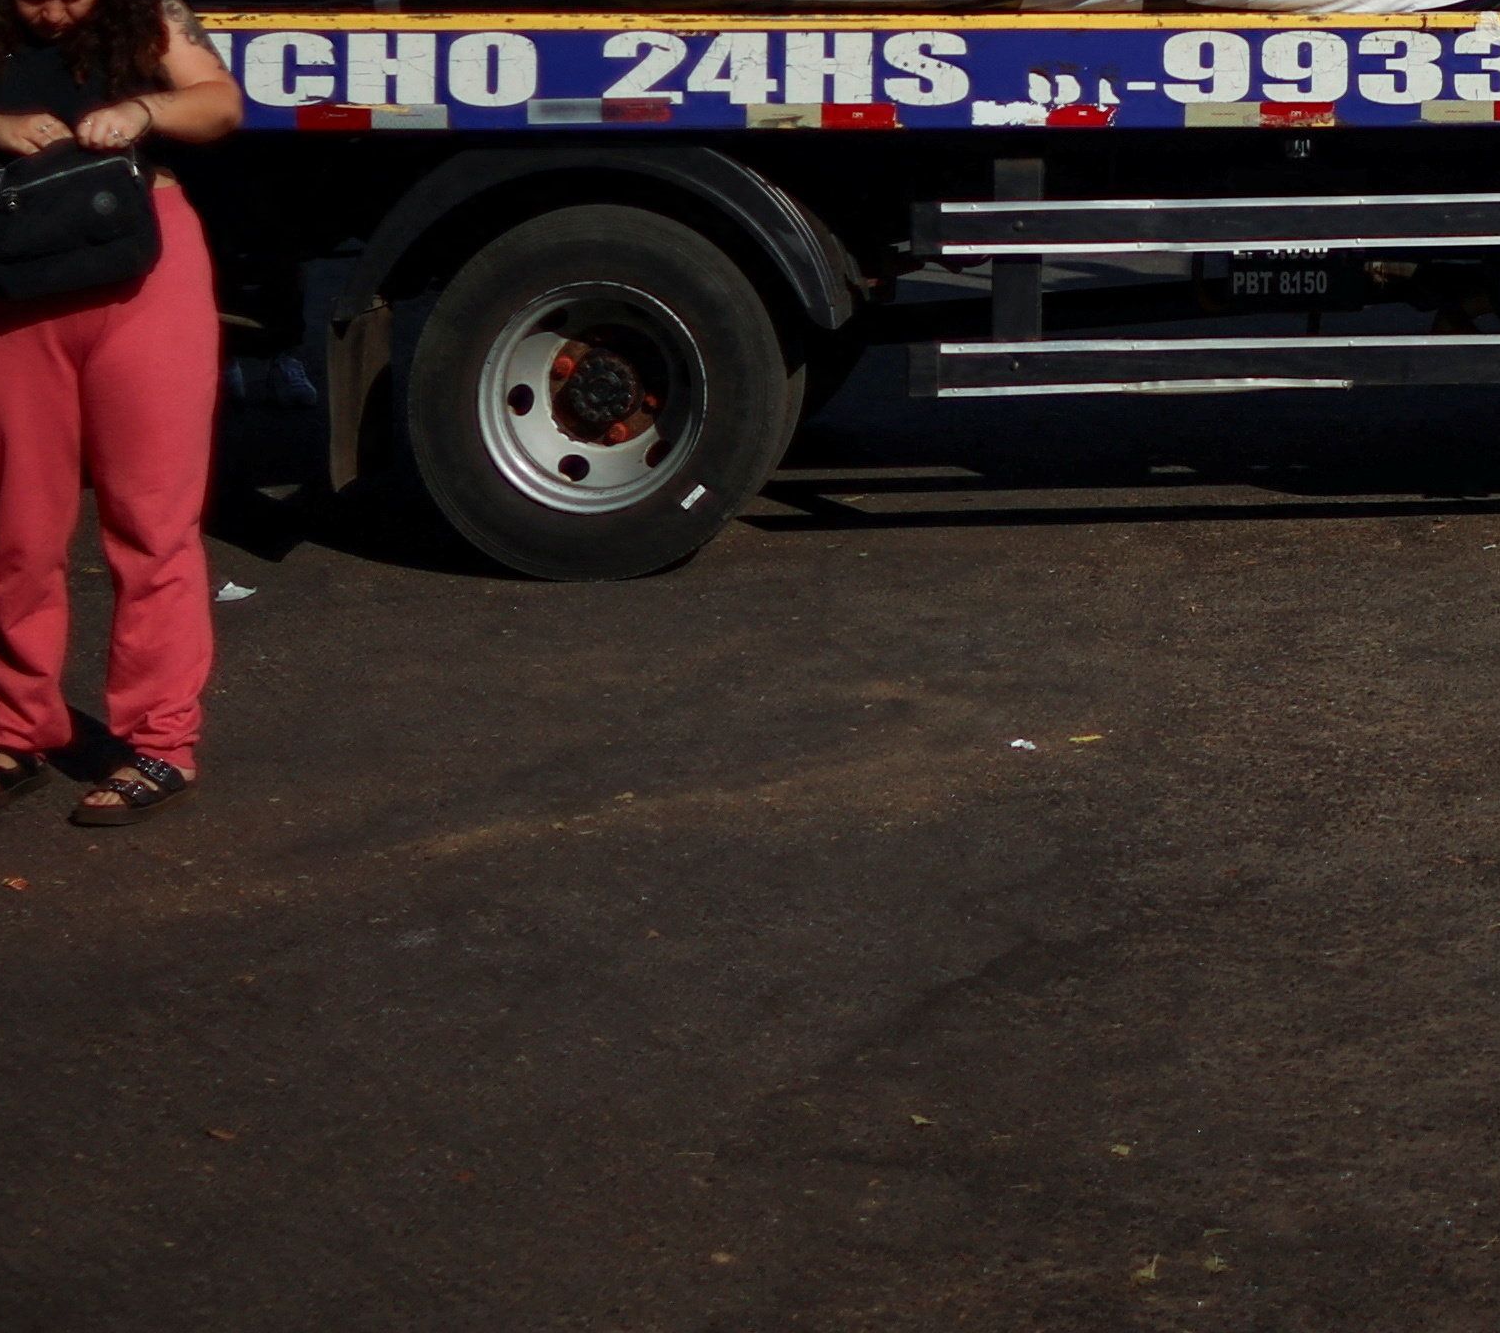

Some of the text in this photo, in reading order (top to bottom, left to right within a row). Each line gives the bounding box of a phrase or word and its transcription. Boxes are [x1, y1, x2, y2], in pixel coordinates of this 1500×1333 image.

[602, 29, 970, 107] 24HS
[1233, 270, 1328, 294] PBT 8.150
